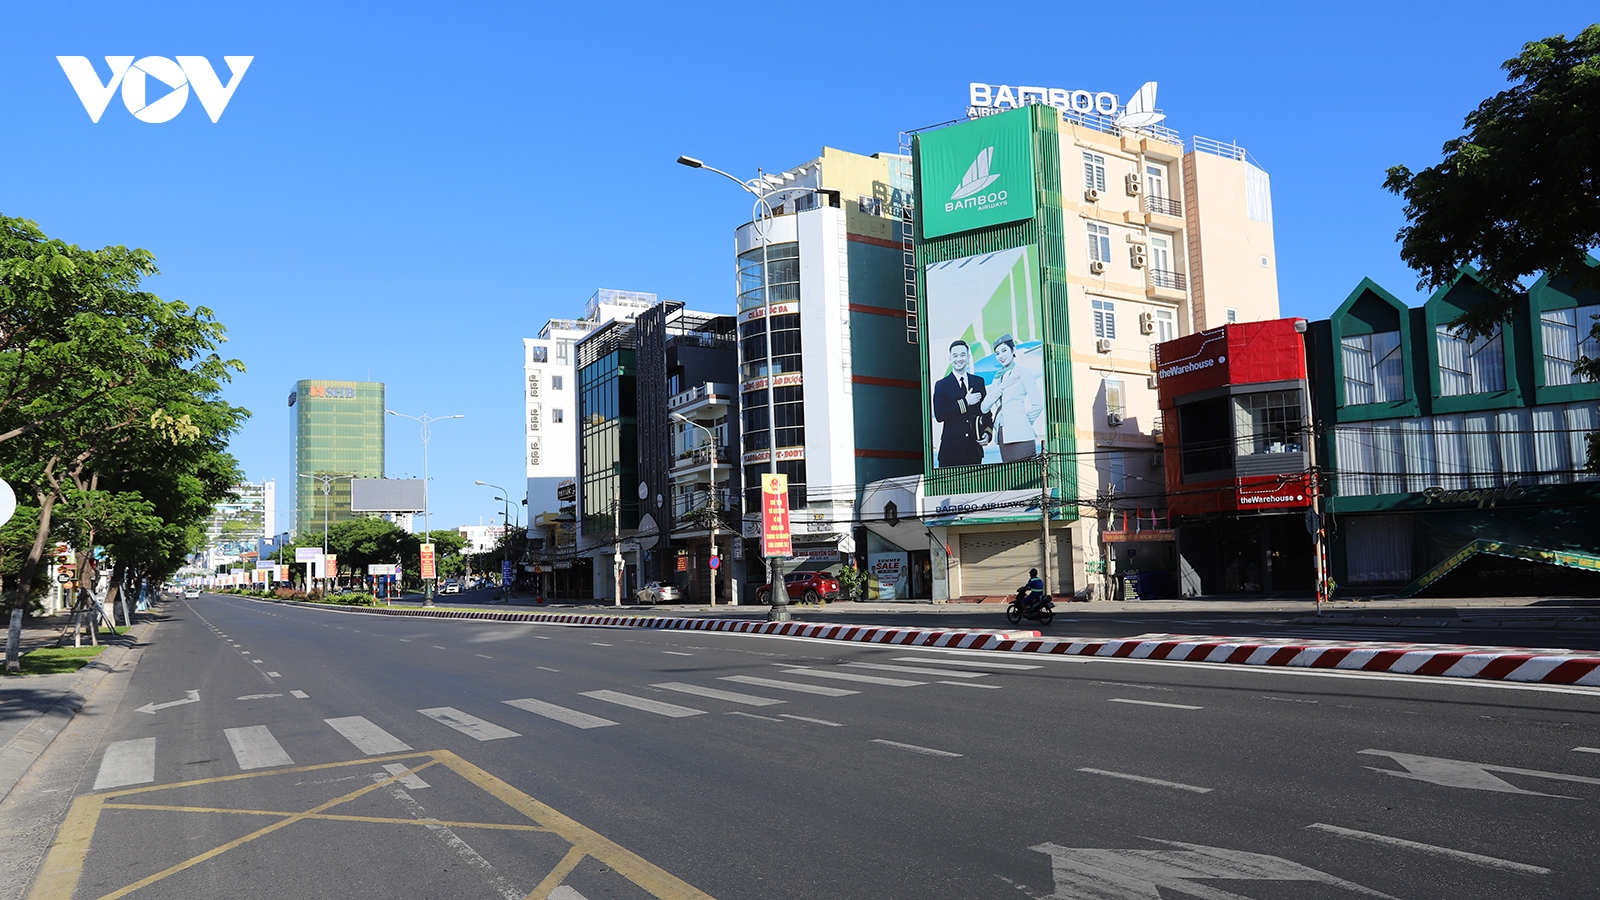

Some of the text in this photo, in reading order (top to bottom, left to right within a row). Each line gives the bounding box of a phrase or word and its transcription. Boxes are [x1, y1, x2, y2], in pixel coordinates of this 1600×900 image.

[970, 82, 1118, 116] BAMBOO
[945, 190, 1008, 213] BAMBOO
[977, 200, 1008, 211] AIRWAYS
[1159, 358, 1215, 379] theWarehouse
[325, 386, 355, 399] SHB
[1240, 495, 1294, 505] theWarehouse
[1422, 480, 1527, 509] Pineapple
[935, 503, 978, 514] BAMBOO
[876, 562, 900, 570] SALE
[1418, 541, 1478, 587] BAKERY
